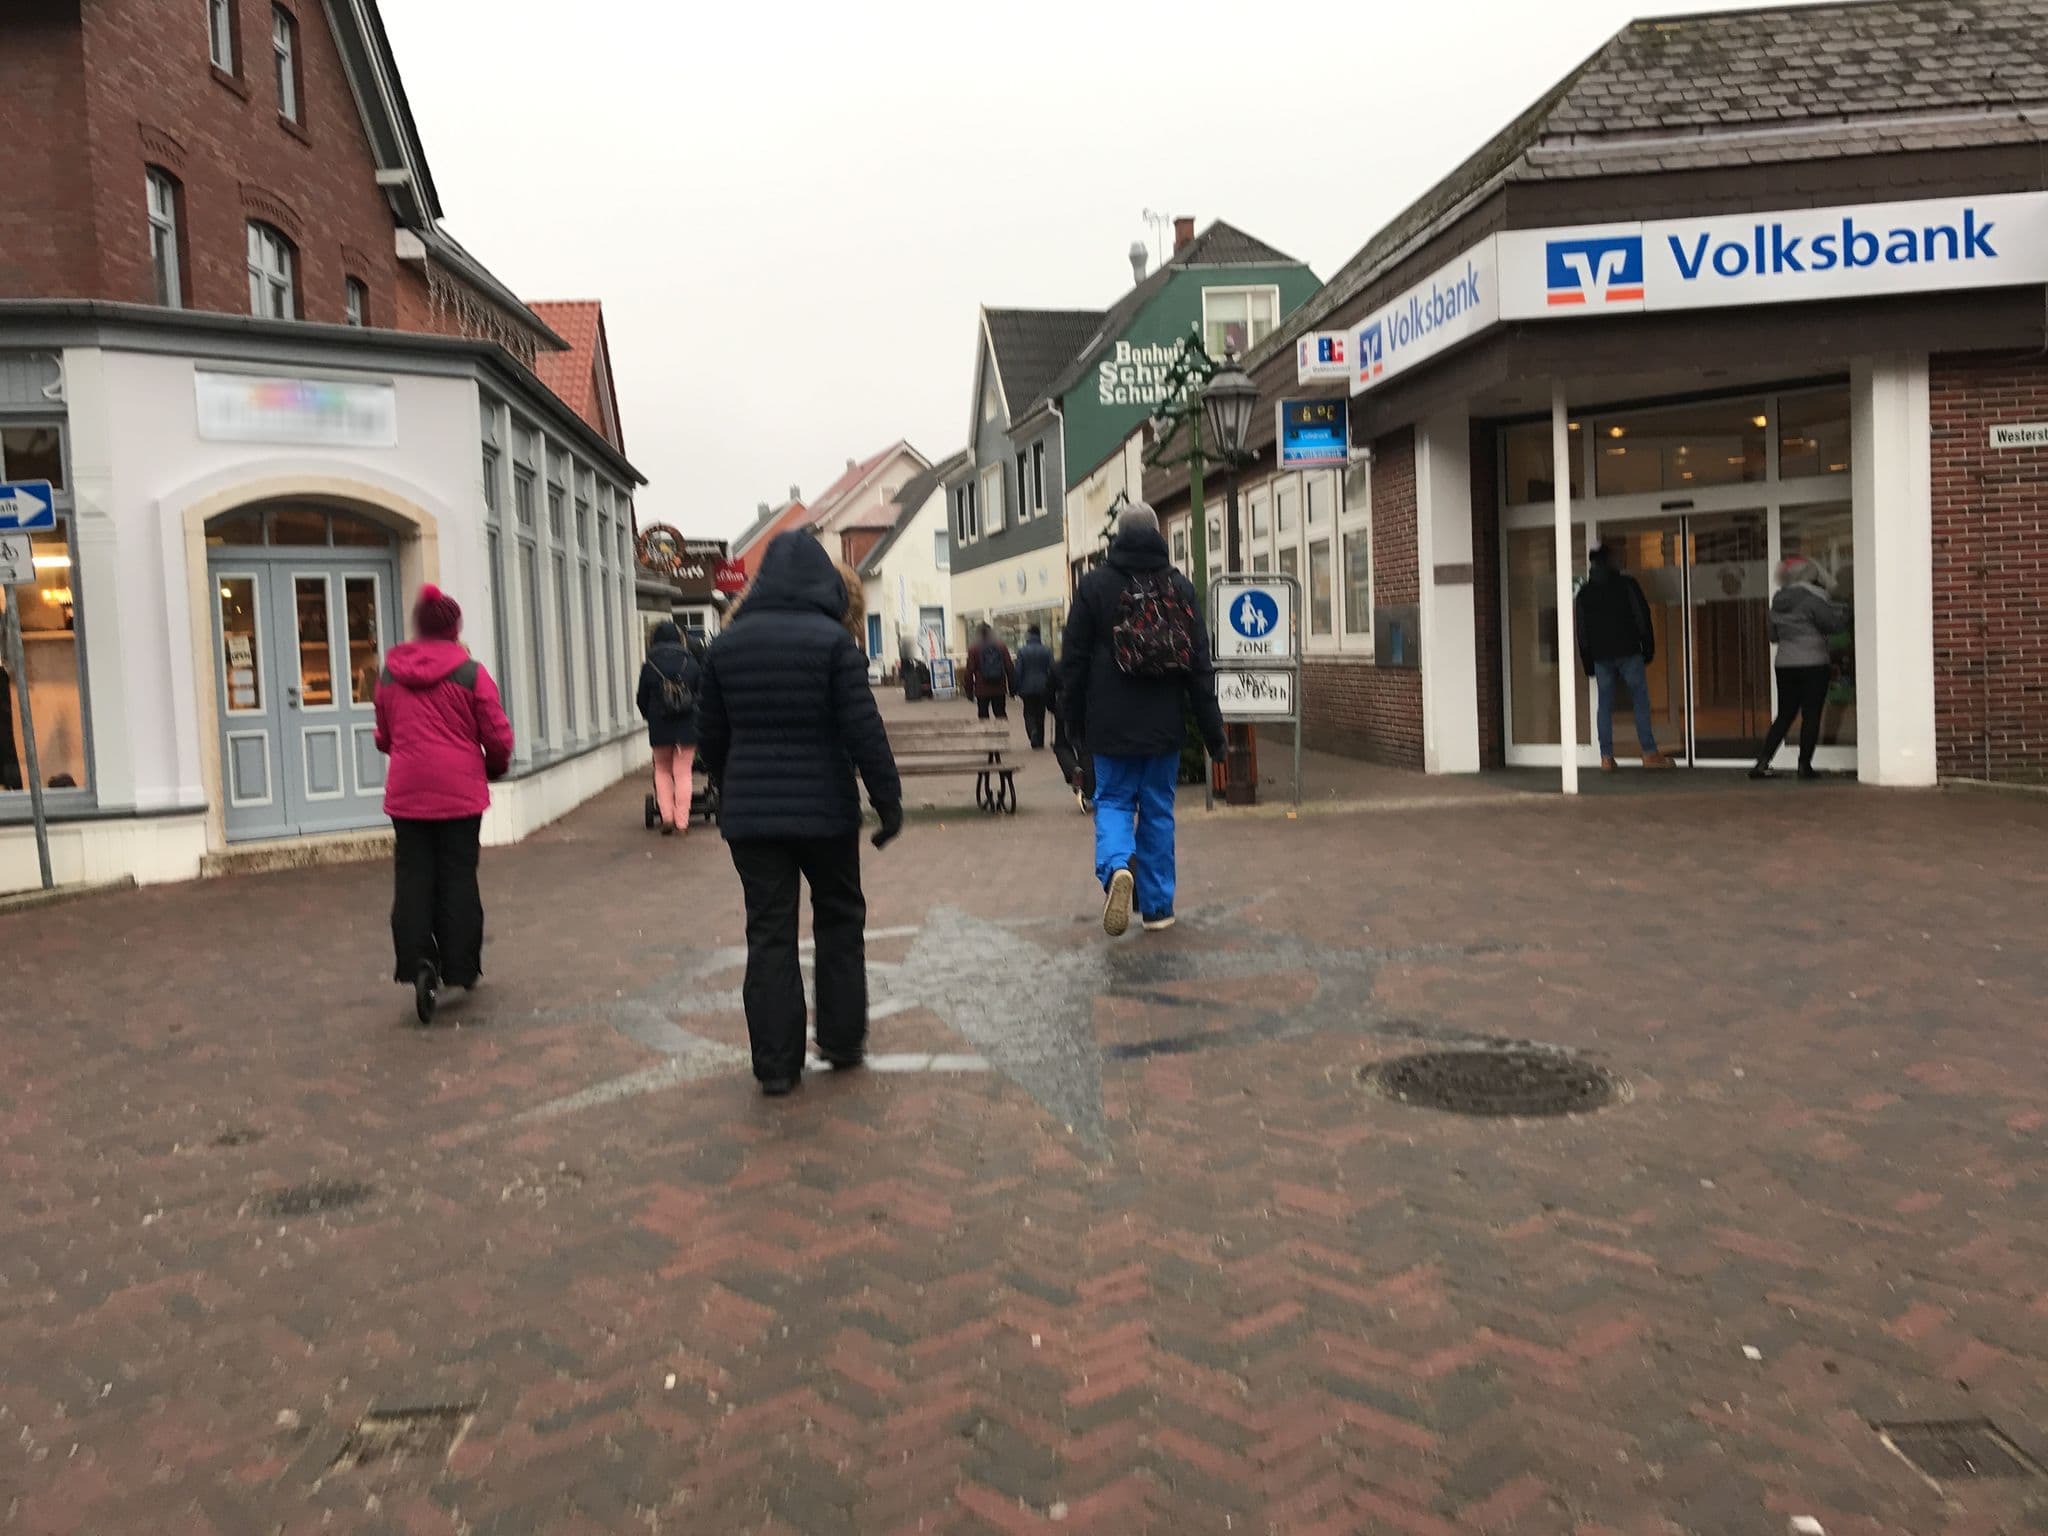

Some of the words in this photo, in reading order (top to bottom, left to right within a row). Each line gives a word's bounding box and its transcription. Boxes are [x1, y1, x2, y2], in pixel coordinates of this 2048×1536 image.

[1667, 208, 1998, 280] Volksbank
[1387, 260, 1480, 352] Volksbank
[1235, 640, 1272, 654] ZONE
